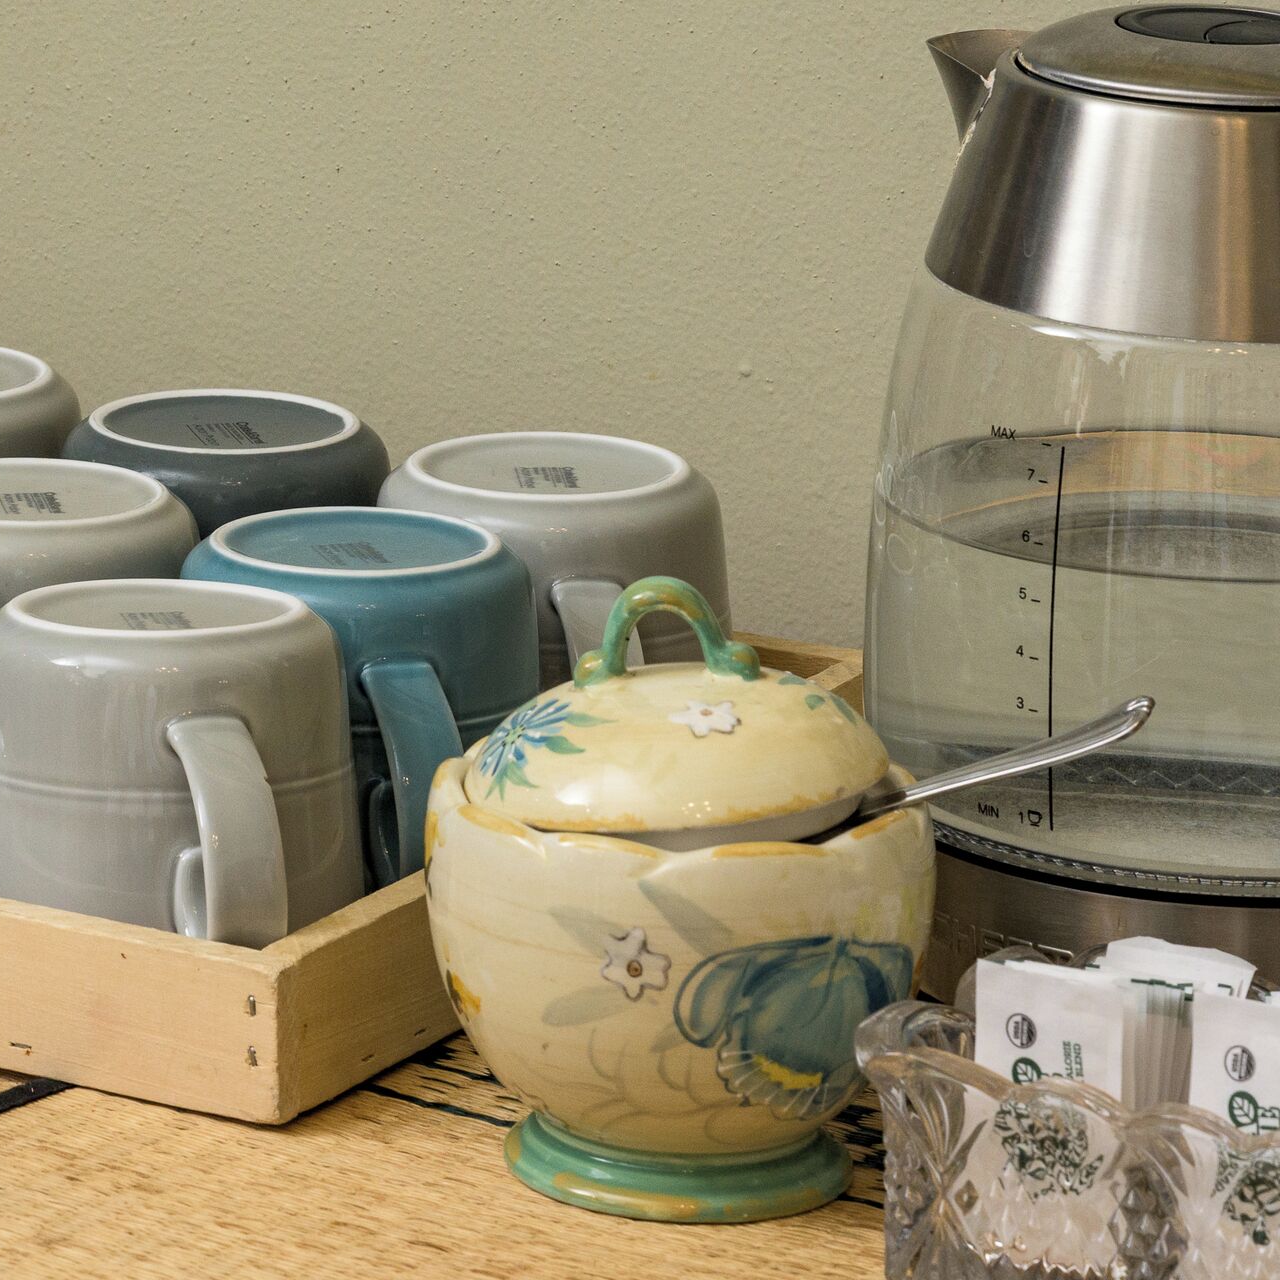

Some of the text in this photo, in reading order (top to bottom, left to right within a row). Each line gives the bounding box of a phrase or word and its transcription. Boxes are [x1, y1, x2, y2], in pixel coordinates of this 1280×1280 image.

[991, 425, 1017, 441] MAX
[1027, 470, 1036, 481] 7
[1021, 530, 1030, 542] 6
[1019, 588, 1027, 600] 5
[1015, 645, 1024, 657] 4
[1016, 697, 1025, 709] 3
[977, 802, 999, 818] MIN
